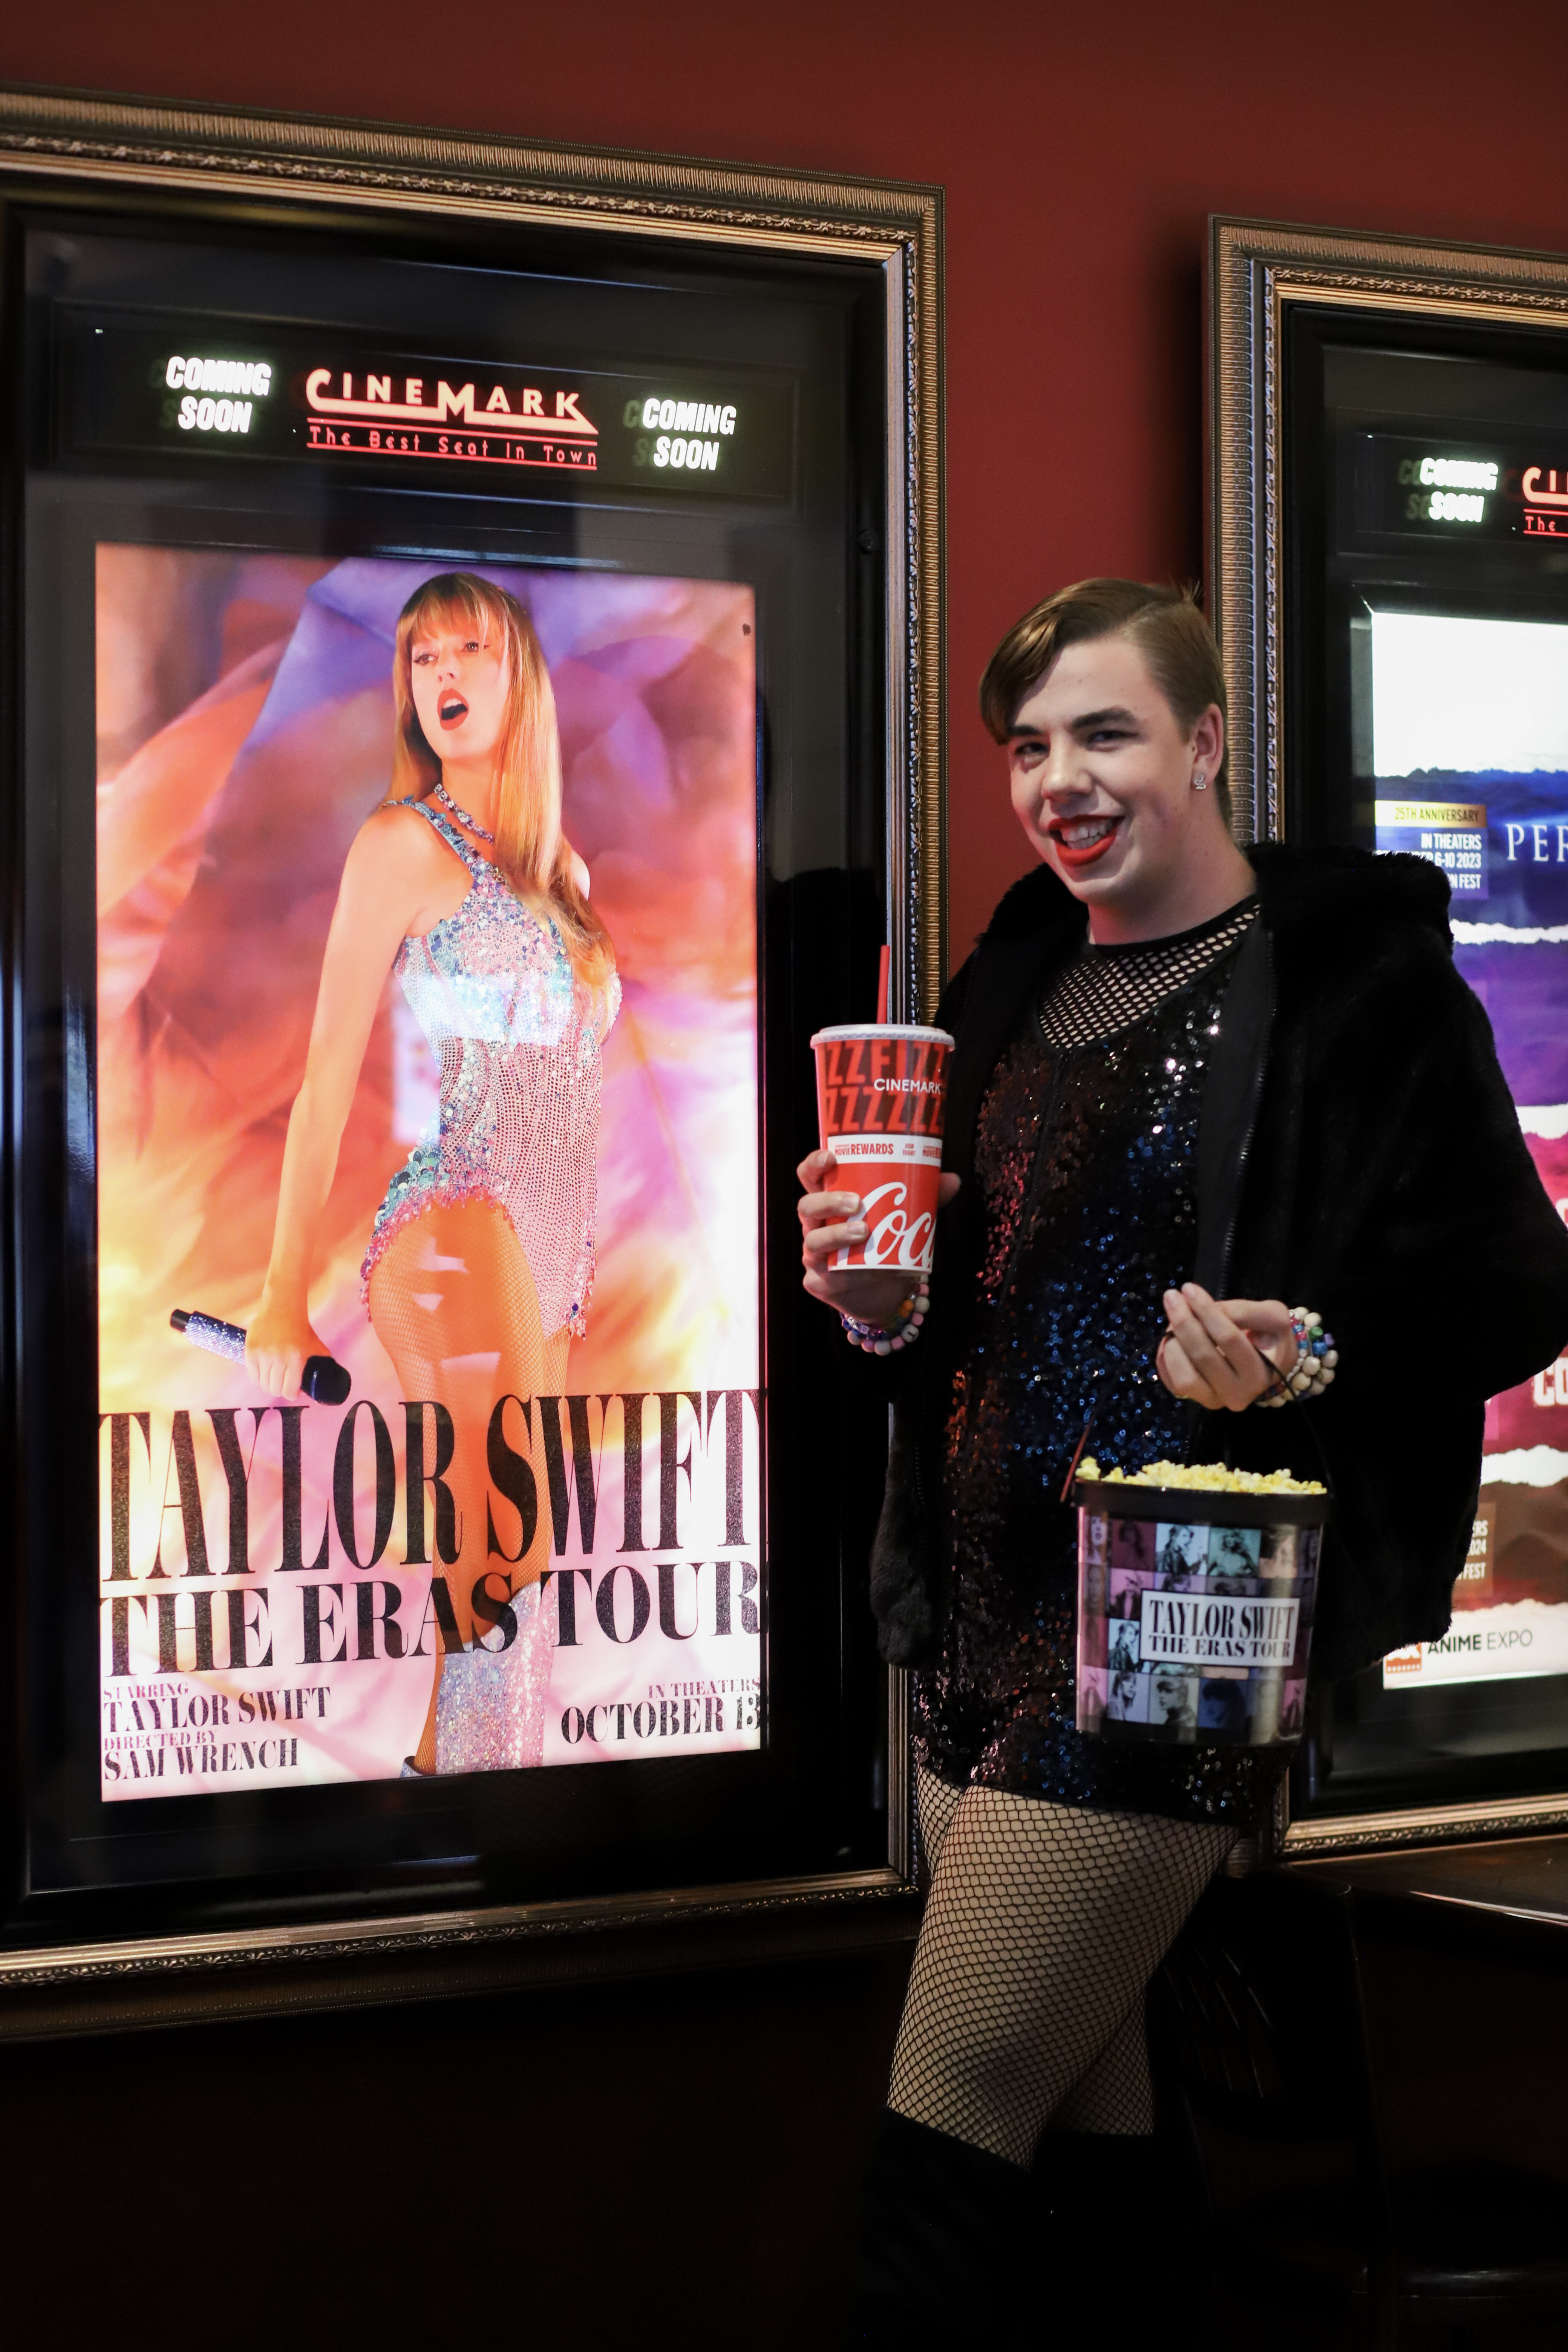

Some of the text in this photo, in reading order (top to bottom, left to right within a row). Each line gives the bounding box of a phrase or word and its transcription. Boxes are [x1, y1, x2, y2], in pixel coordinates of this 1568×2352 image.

[166, 356, 271, 396] COMING
[178, 396, 253, 433] SOON
[306, 369, 599, 434] CINEMARK
[643, 398, 737, 435] COMING
[309, 426, 597, 466] The Best Seat In Town
[654, 436, 720, 470] SOON
[1420, 458, 1498, 490] COMING
[1429, 491, 1484, 522] SOON
[1525, 515, 1556, 531] The
[1395, 807, 1479, 822] 25TH ANNIVERSARY
[1421, 833, 1482, 850] IN THEATERS
[1435, 852, 1455, 868] 6-10
[1456, 852, 1482, 868] 2023
[1459, 873, 1481, 889] FEST
[874, 1078, 940, 1094] CINEMARK
[851, 1143, 894, 1155] REWARDS
[99, 1389, 760, 1582] TAYLOR SWIFT
[1467, 1539, 1487, 1556] 024
[1463, 1562, 1486, 1579] FEST
[101, 1560, 760, 1678] THE ERAS TOUR
[1150, 1600, 1295, 1640] TAYLOR SWIFT
[1149, 1635, 1291, 1658] THE ERAS TOUR
[1428, 1634, 1481, 1654] ANIME
[1487, 1629, 1533, 1649] EXPO
[104, 1682, 188, 1700] STARRING
[649, 1677, 760, 1698] IN THEATERS
[104, 1687, 331, 1732] TAYLOR SWIFT
[561, 1694, 760, 1744] OCTOBER 13
[104, 1730, 217, 1750] DIRECTED BY
[105, 1738, 300, 1781] SAM WRENCH
